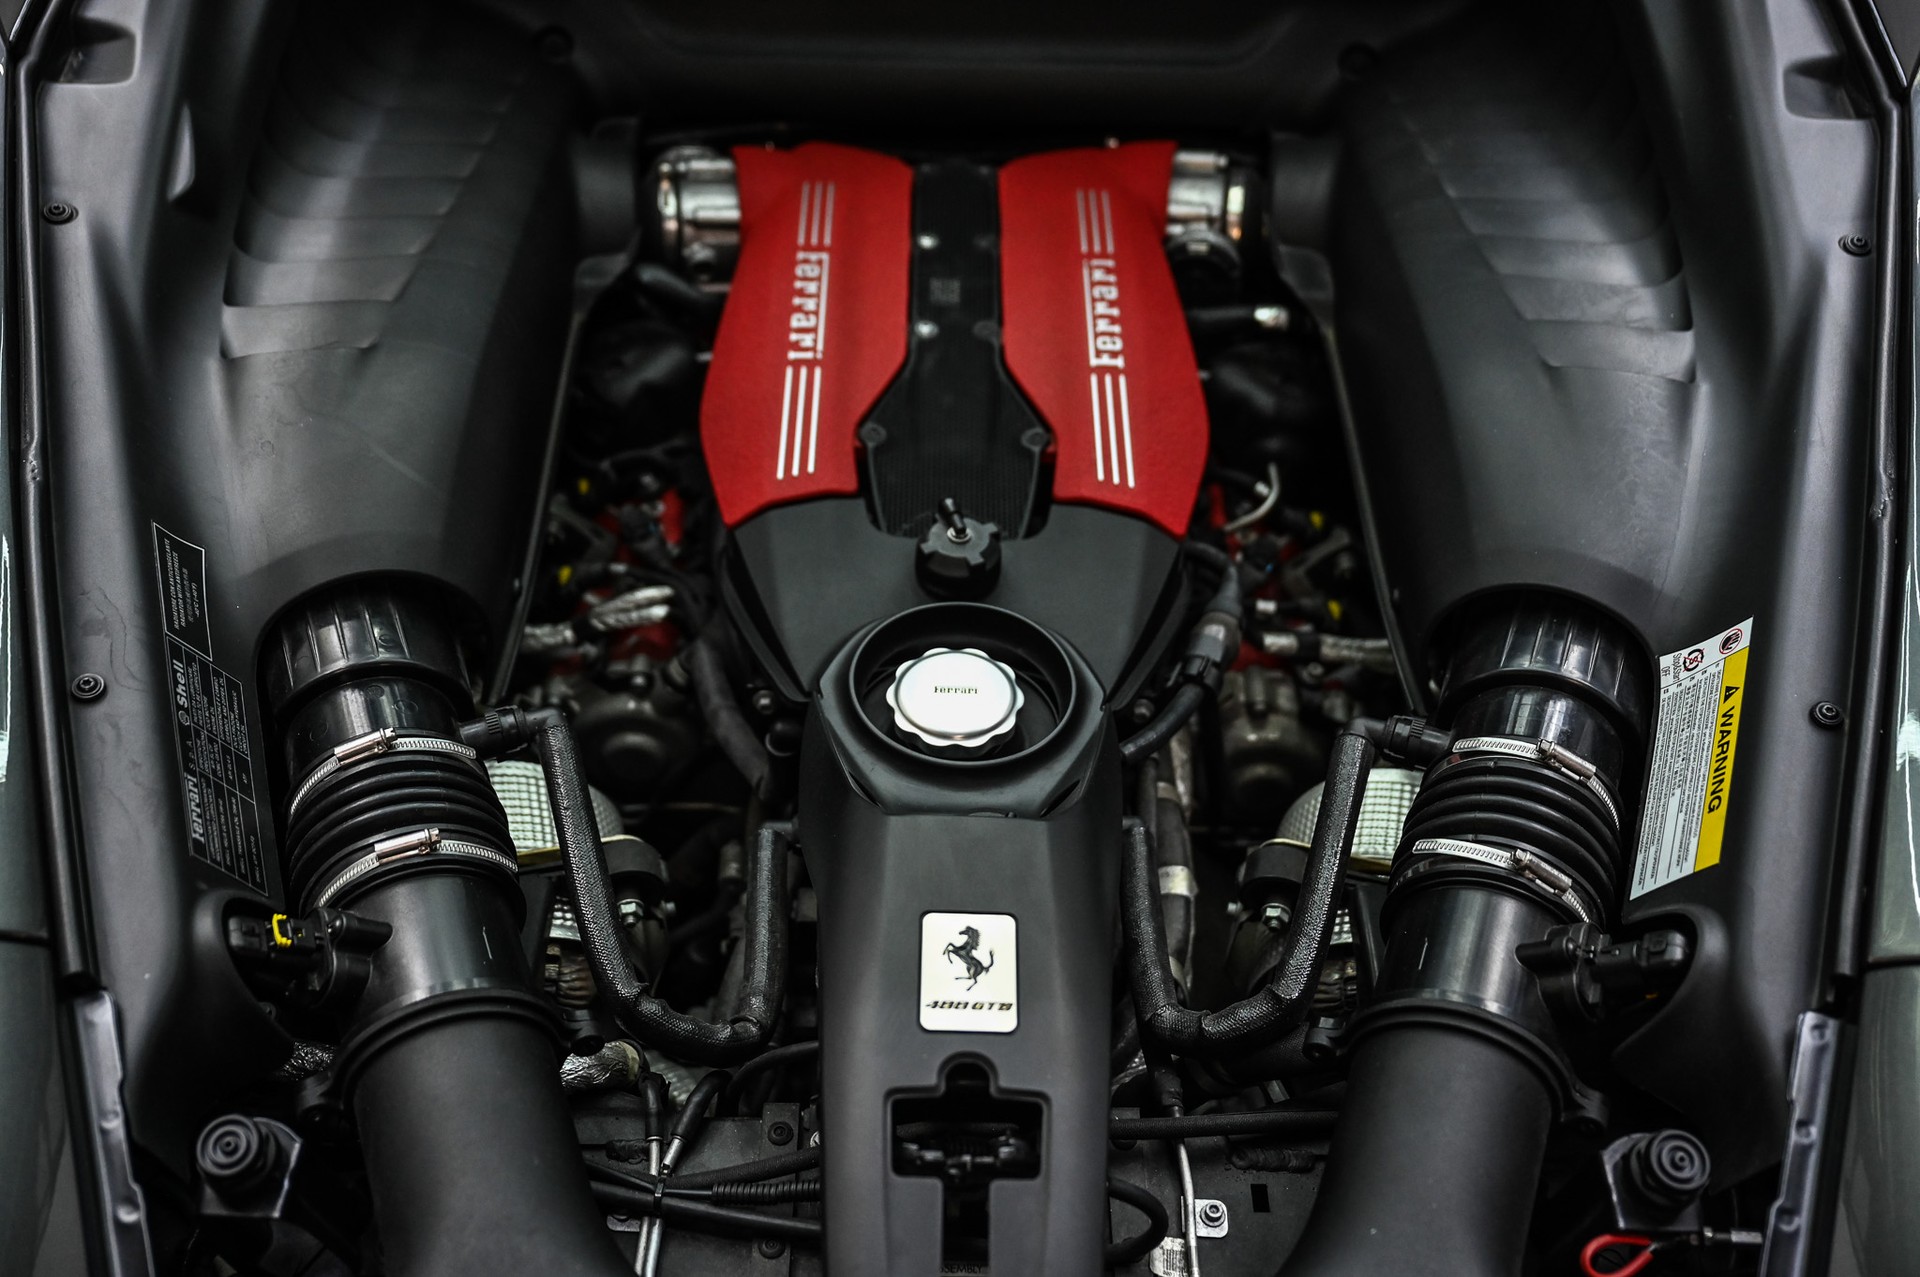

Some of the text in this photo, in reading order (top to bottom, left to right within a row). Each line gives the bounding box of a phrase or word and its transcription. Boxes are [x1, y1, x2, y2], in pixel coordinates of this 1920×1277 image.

[787, 251, 829, 360] Ferrari
[1083, 259, 1125, 368] Ferrari
[173, 659, 188, 708] Shell
[934, 686, 978, 694] Ferrari
[1661, 666, 1671, 677] OFF
[1708, 706, 1735, 814] WARNING
[184, 772, 204, 843] Ferrari
